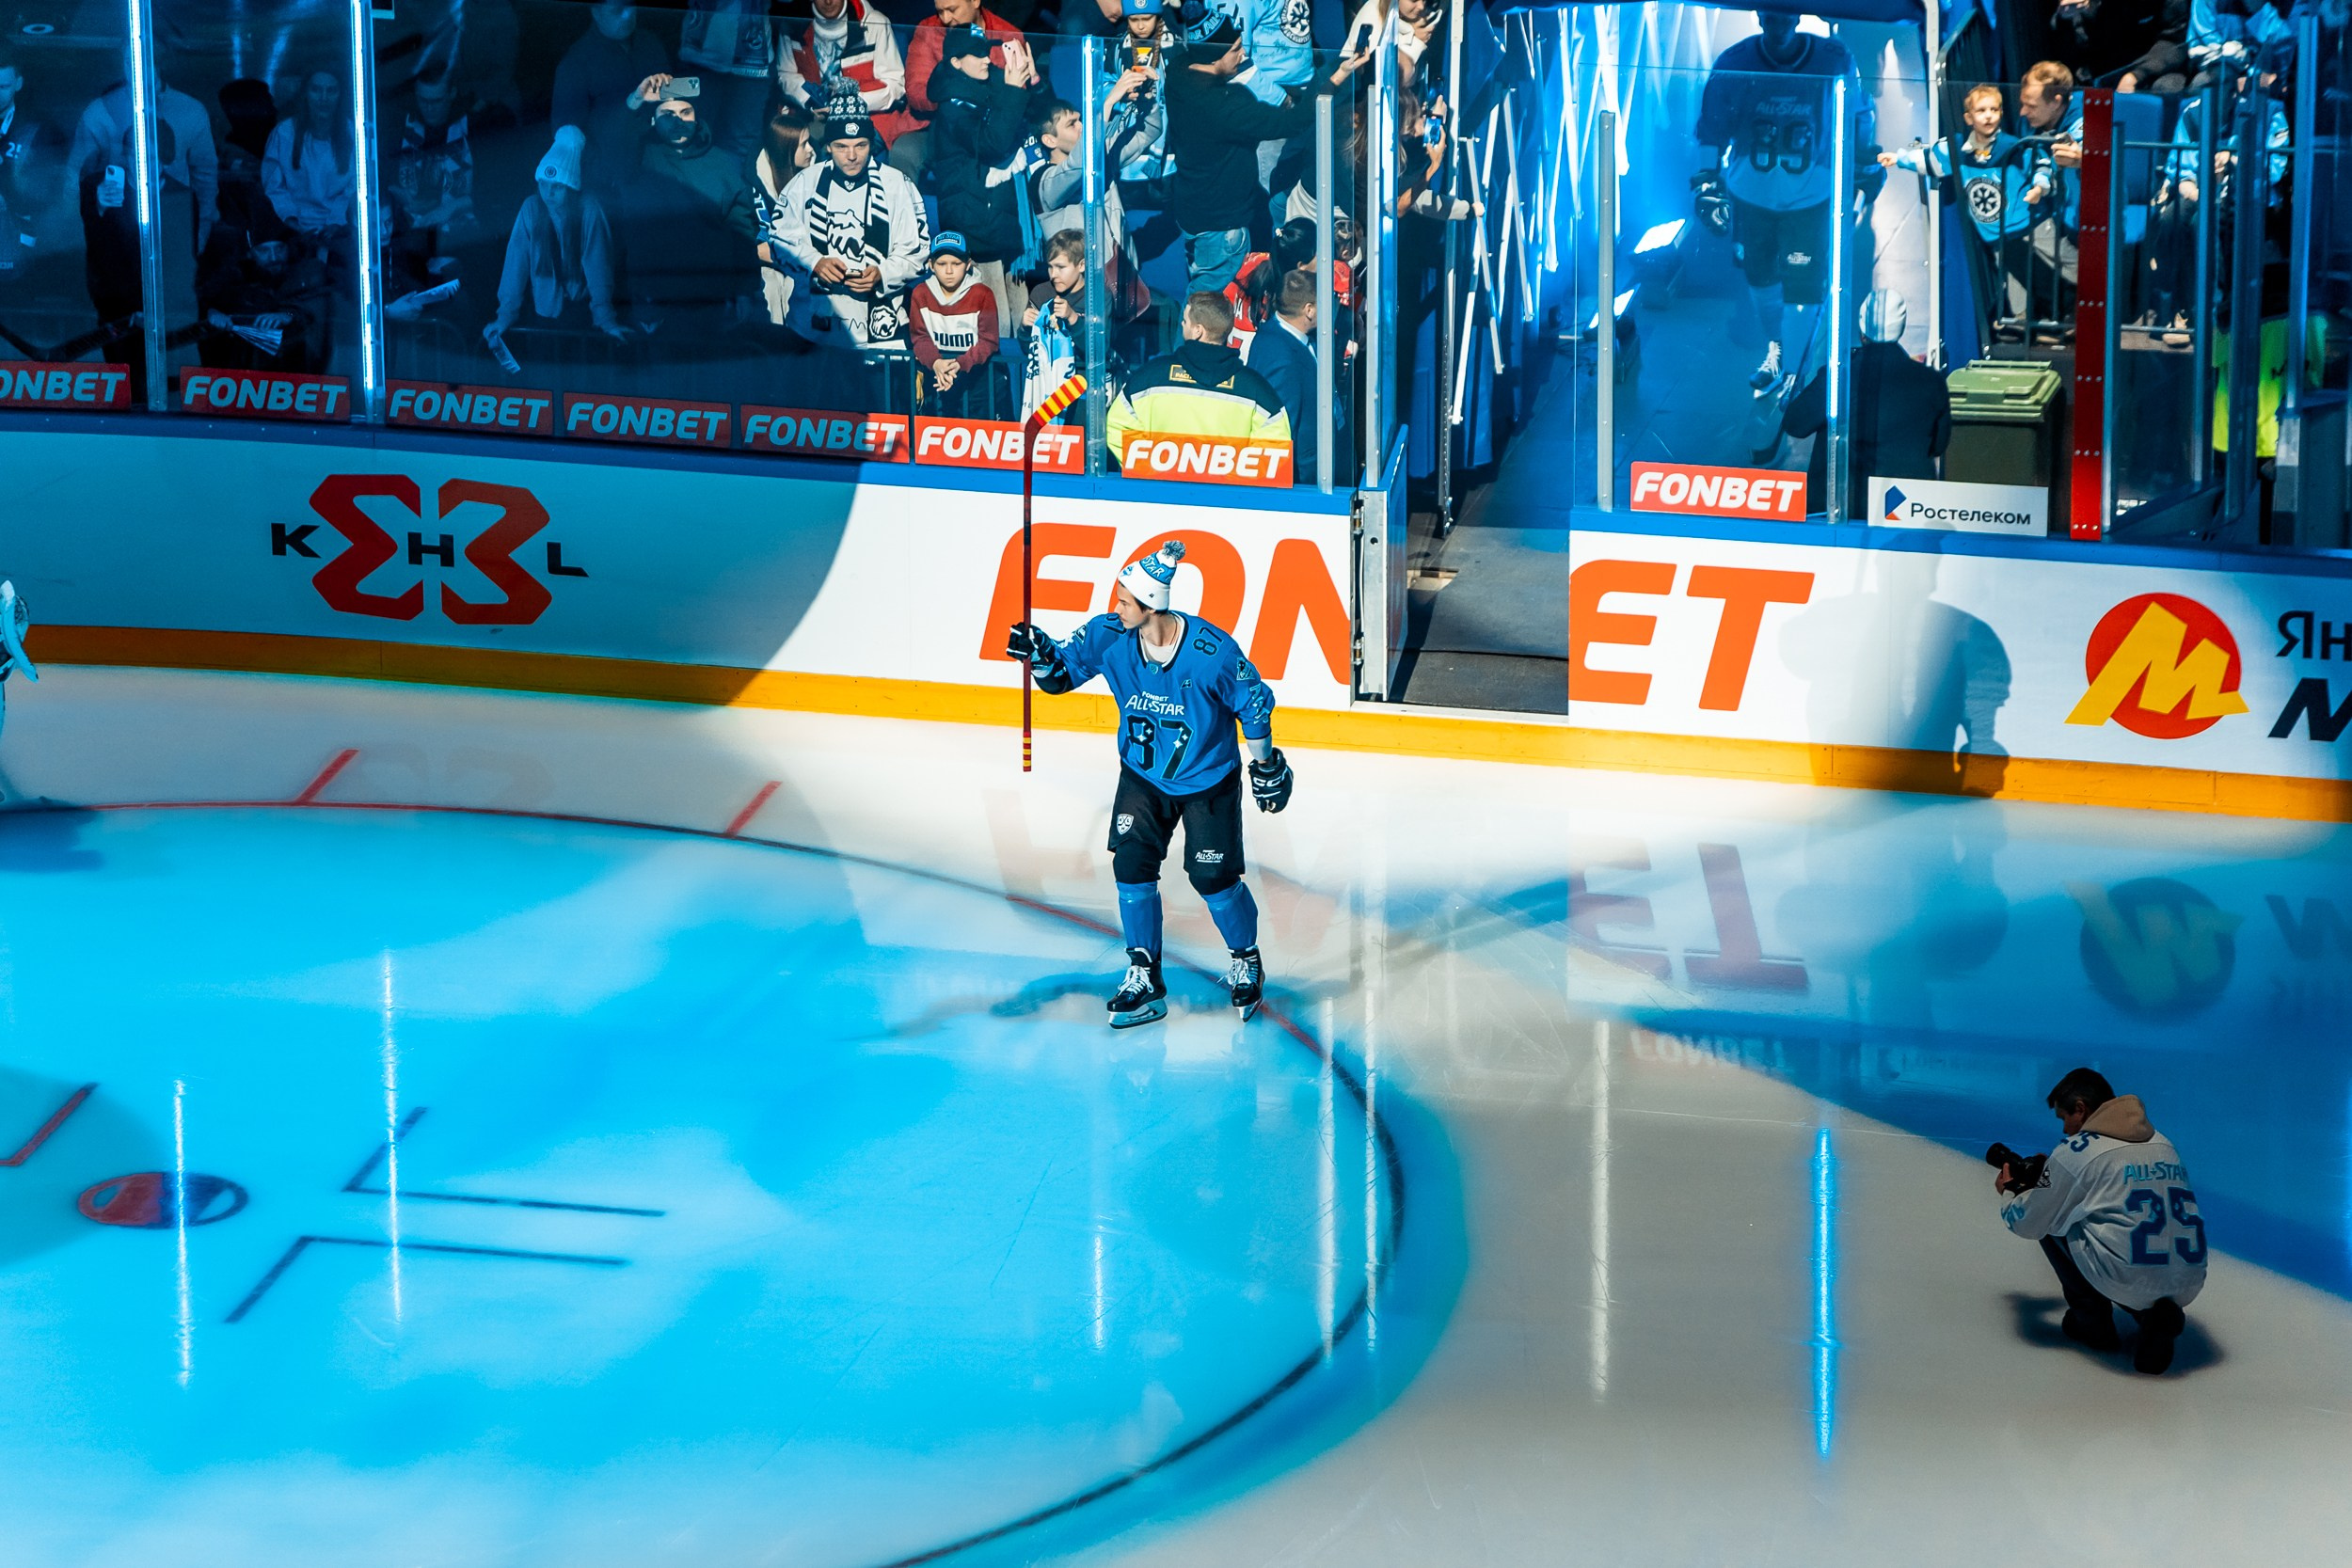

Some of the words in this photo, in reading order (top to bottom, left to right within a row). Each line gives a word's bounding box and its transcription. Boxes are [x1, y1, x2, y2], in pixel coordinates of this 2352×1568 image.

[1750, 119, 1813, 175] 89
[183, 375, 347, 414] FONBET
[389, 388, 549, 428] FONBET
[566, 402, 728, 441] FONBET
[743, 414, 905, 453] FONBET
[918, 426, 1081, 466] FONBET
[1125, 439, 1290, 480] FONBET
[1633, 471, 1804, 513] FONBET
[1910, 502, 2031, 526] Ростелеком
[1126, 713, 1194, 781] 87
[2124, 1186, 2208, 1265] 25
